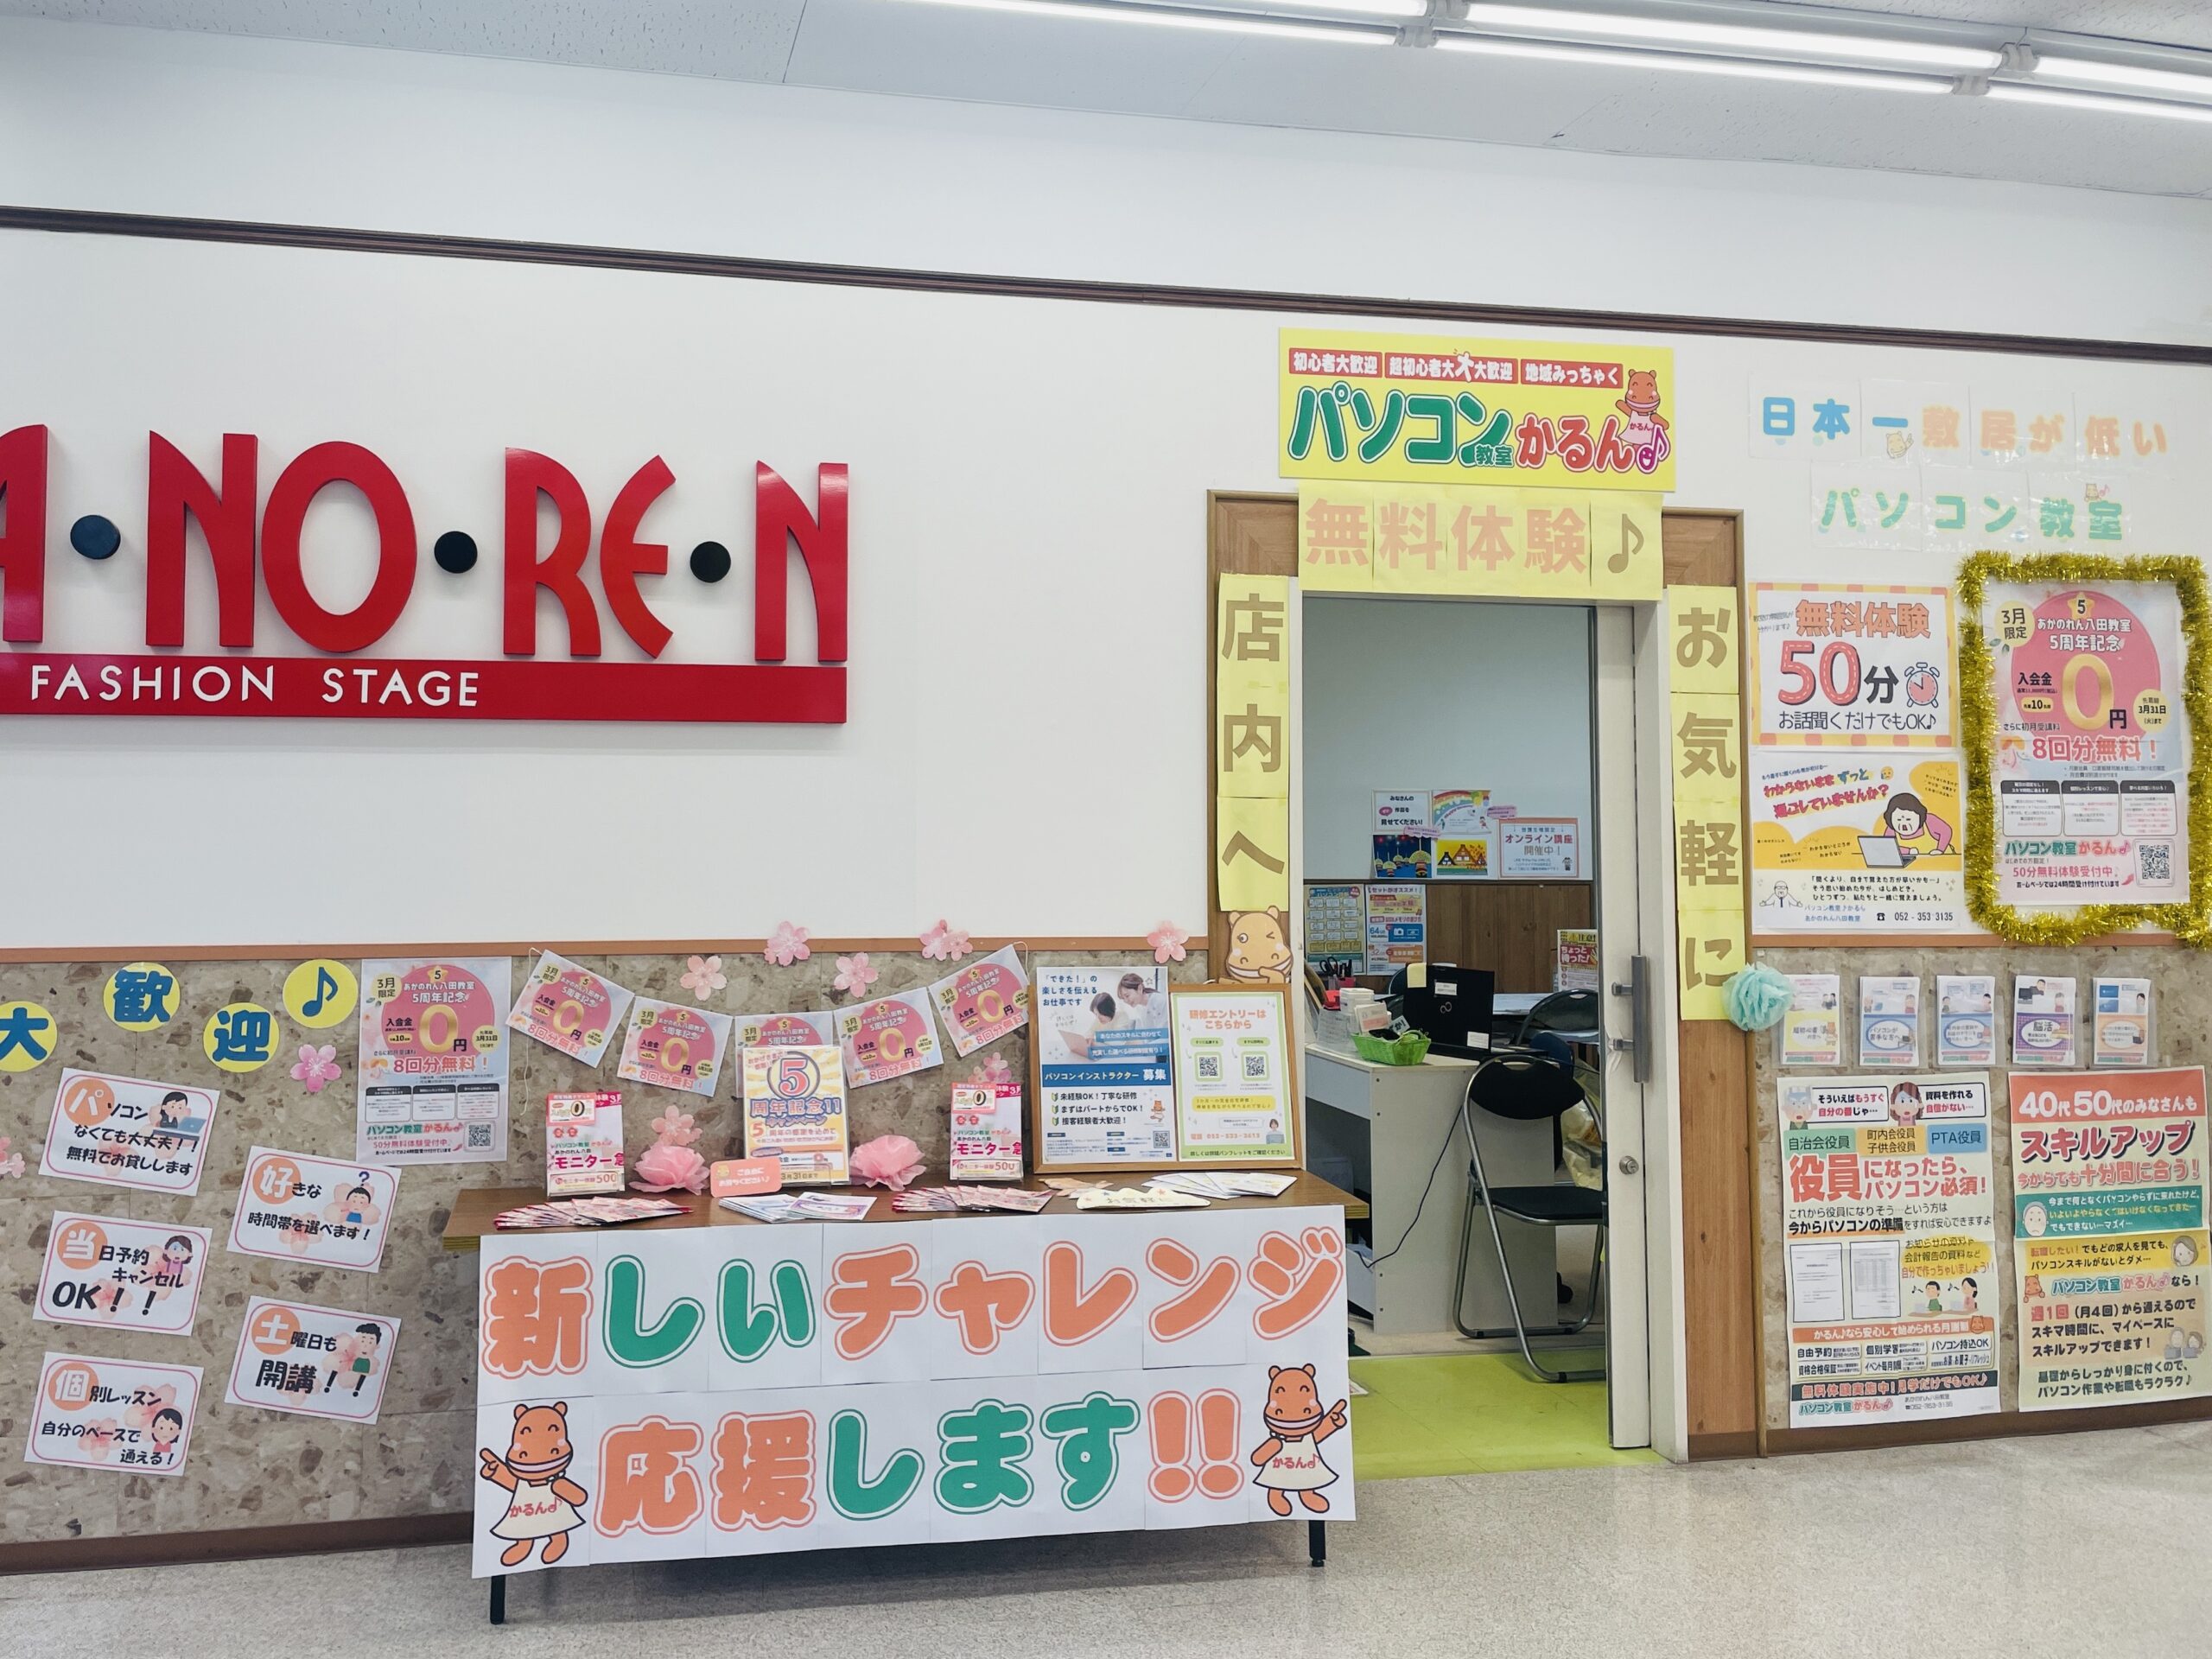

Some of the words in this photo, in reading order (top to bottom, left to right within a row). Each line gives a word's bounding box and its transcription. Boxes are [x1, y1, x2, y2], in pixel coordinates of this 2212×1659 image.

[1294, 353, 1377, 376] 初心者大歓迎
[1525, 362, 1618, 385] 地域みっちゃく
[1287, 380, 1513, 467] パソコン
[1475, 443, 1514, 467] 教室
[1516, 412, 1637, 473] かるん
[1763, 397, 2168, 457] 日本一敷居が低い
[1821, 488, 2123, 541] パソコン教室
[1305, 499, 1587, 574] 無料体験
[2077, 600, 2085, 613] 5
[1796, 600, 1931, 638] 無料体験
[2002, 608, 2025, 624] 3月
[2004, 627, 2027, 639] 限定
[2037, 619, 2132, 632] あかのれん八田教室
[2050, 634, 2120, 652] 5周年記念
[30, 664, 274, 702] FASHION
[322, 669, 480, 709] STAGE
[2018, 673, 2052, 685] 入会金
[2062, 654, 2114, 730] 0
[2109, 709, 2127, 728] 円
[2139, 705, 2166, 714] 3月31日
[1222, 593, 1285, 874] 店内へ
[1838, 768, 1869, 784] ずっと
[1505, 835, 1573, 844] オンライン講座
[2005, 841, 2077, 856] パソコン教室
[378, 977, 395, 988] 3月
[435, 970, 441, 979] 5
[419, 1004, 459, 1053] 0
[453, 1039, 467, 1052] 円
[1205, 1020, 1252, 1029] こちらから
[779, 1058, 810, 1097] 5
[1143, 1069, 1166, 1081] 募集
[2019, 1090, 2070, 1118] 40代
[1789, 1135, 1850, 1152] 自治会役員
[1866, 1128, 1916, 1141] 町内会役員
[1931, 1131, 1982, 1145] PTA役員
[2020, 1120, 2196, 1163] スキルアップ
[1867, 1142, 1916, 1154] 子供会役員
[67, 1146, 194, 1176] 無料でお貸しします
[1789, 1154, 1862, 1204] 役員
[111, 1268, 183, 1288] キャンセル
[2051, 1276, 2121, 1295] パソコン教室
[483, 1225, 1345, 1380] 新しいチャレンジ
[1797, 1347, 1833, 1358] 自由予約
[41, 1421, 141, 1443] 自分のペースで
[119, 1449, 174, 1465] 通える！
